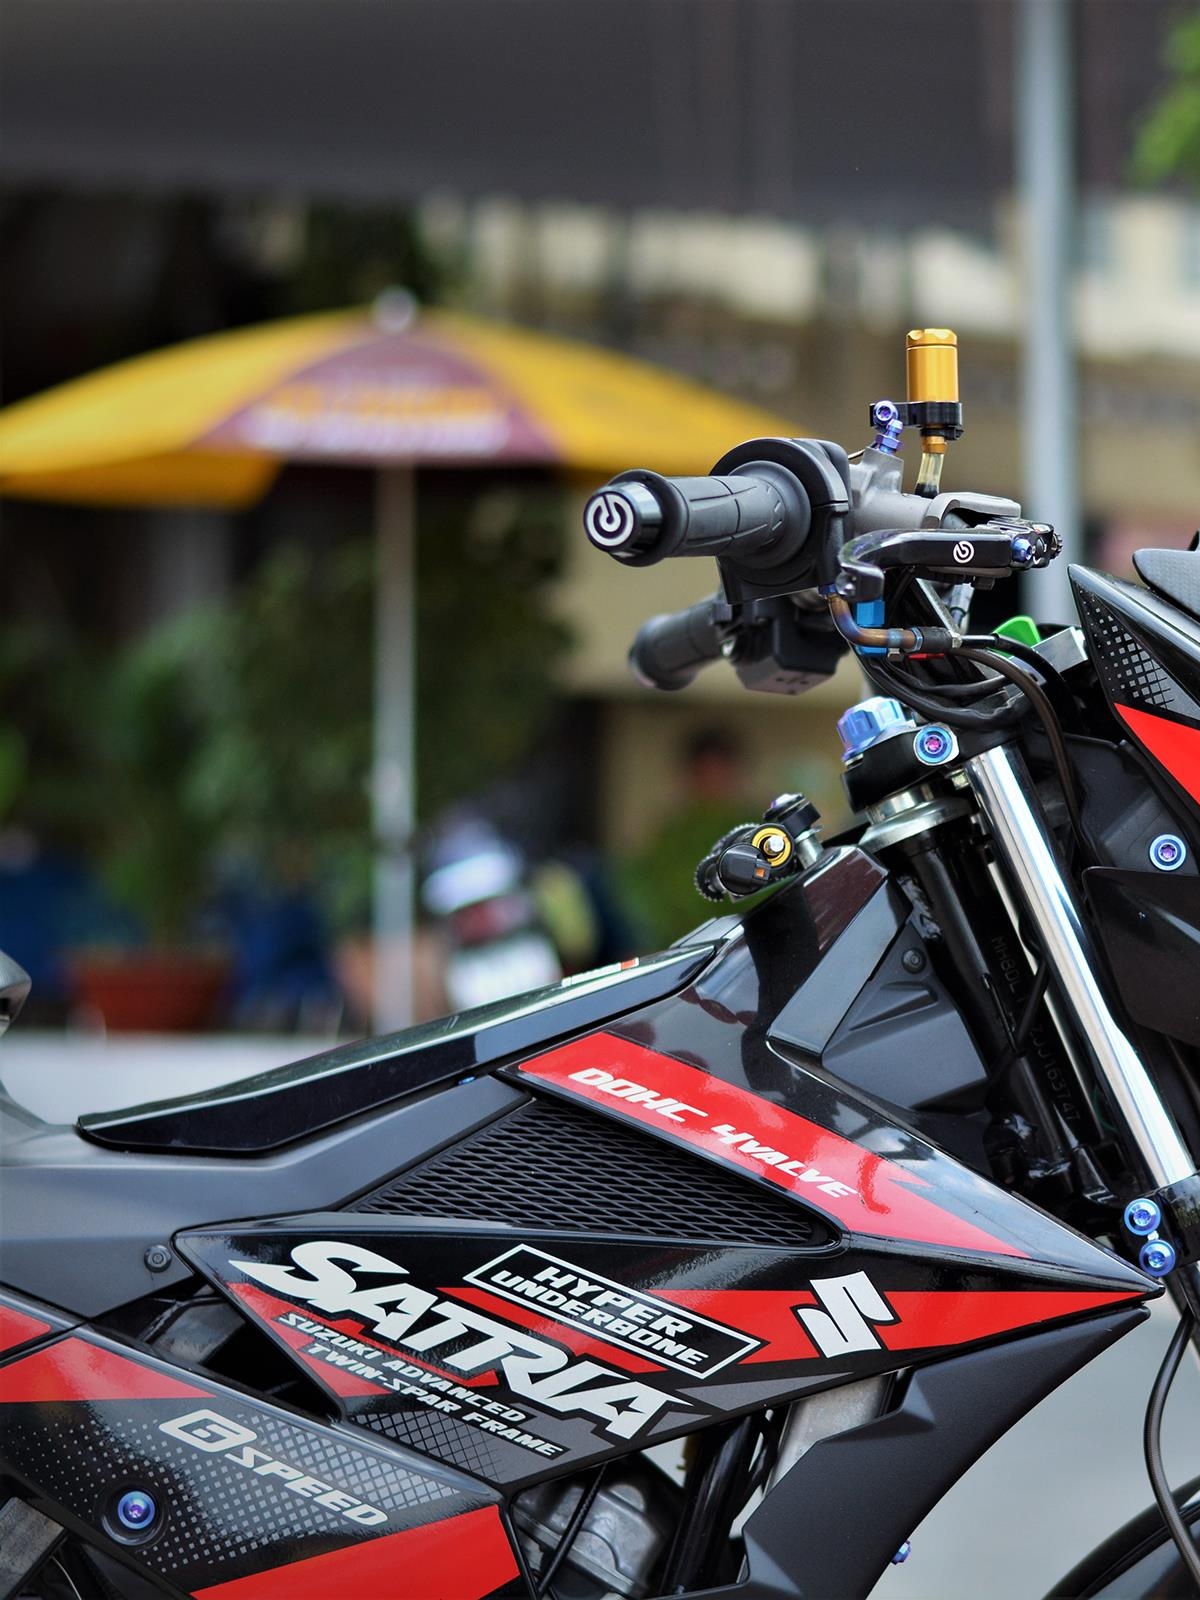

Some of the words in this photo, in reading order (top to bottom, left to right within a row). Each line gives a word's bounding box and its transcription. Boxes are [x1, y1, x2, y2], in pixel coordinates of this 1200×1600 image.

[568, 1068, 708, 1122] DOHC
[229, 1241, 693, 1439] SATRIA
[491, 1271, 709, 1366] UNDERBONE
[533, 1266, 695, 1338] HYPER
[279, 1314, 382, 1360] SUZUKI
[383, 1359, 526, 1422] ADVANCED
[308, 1344, 462, 1413] TWIN-SPAR
[462, 1411, 563, 1456] FRAME
[225, 1447, 388, 1525] SPEED
